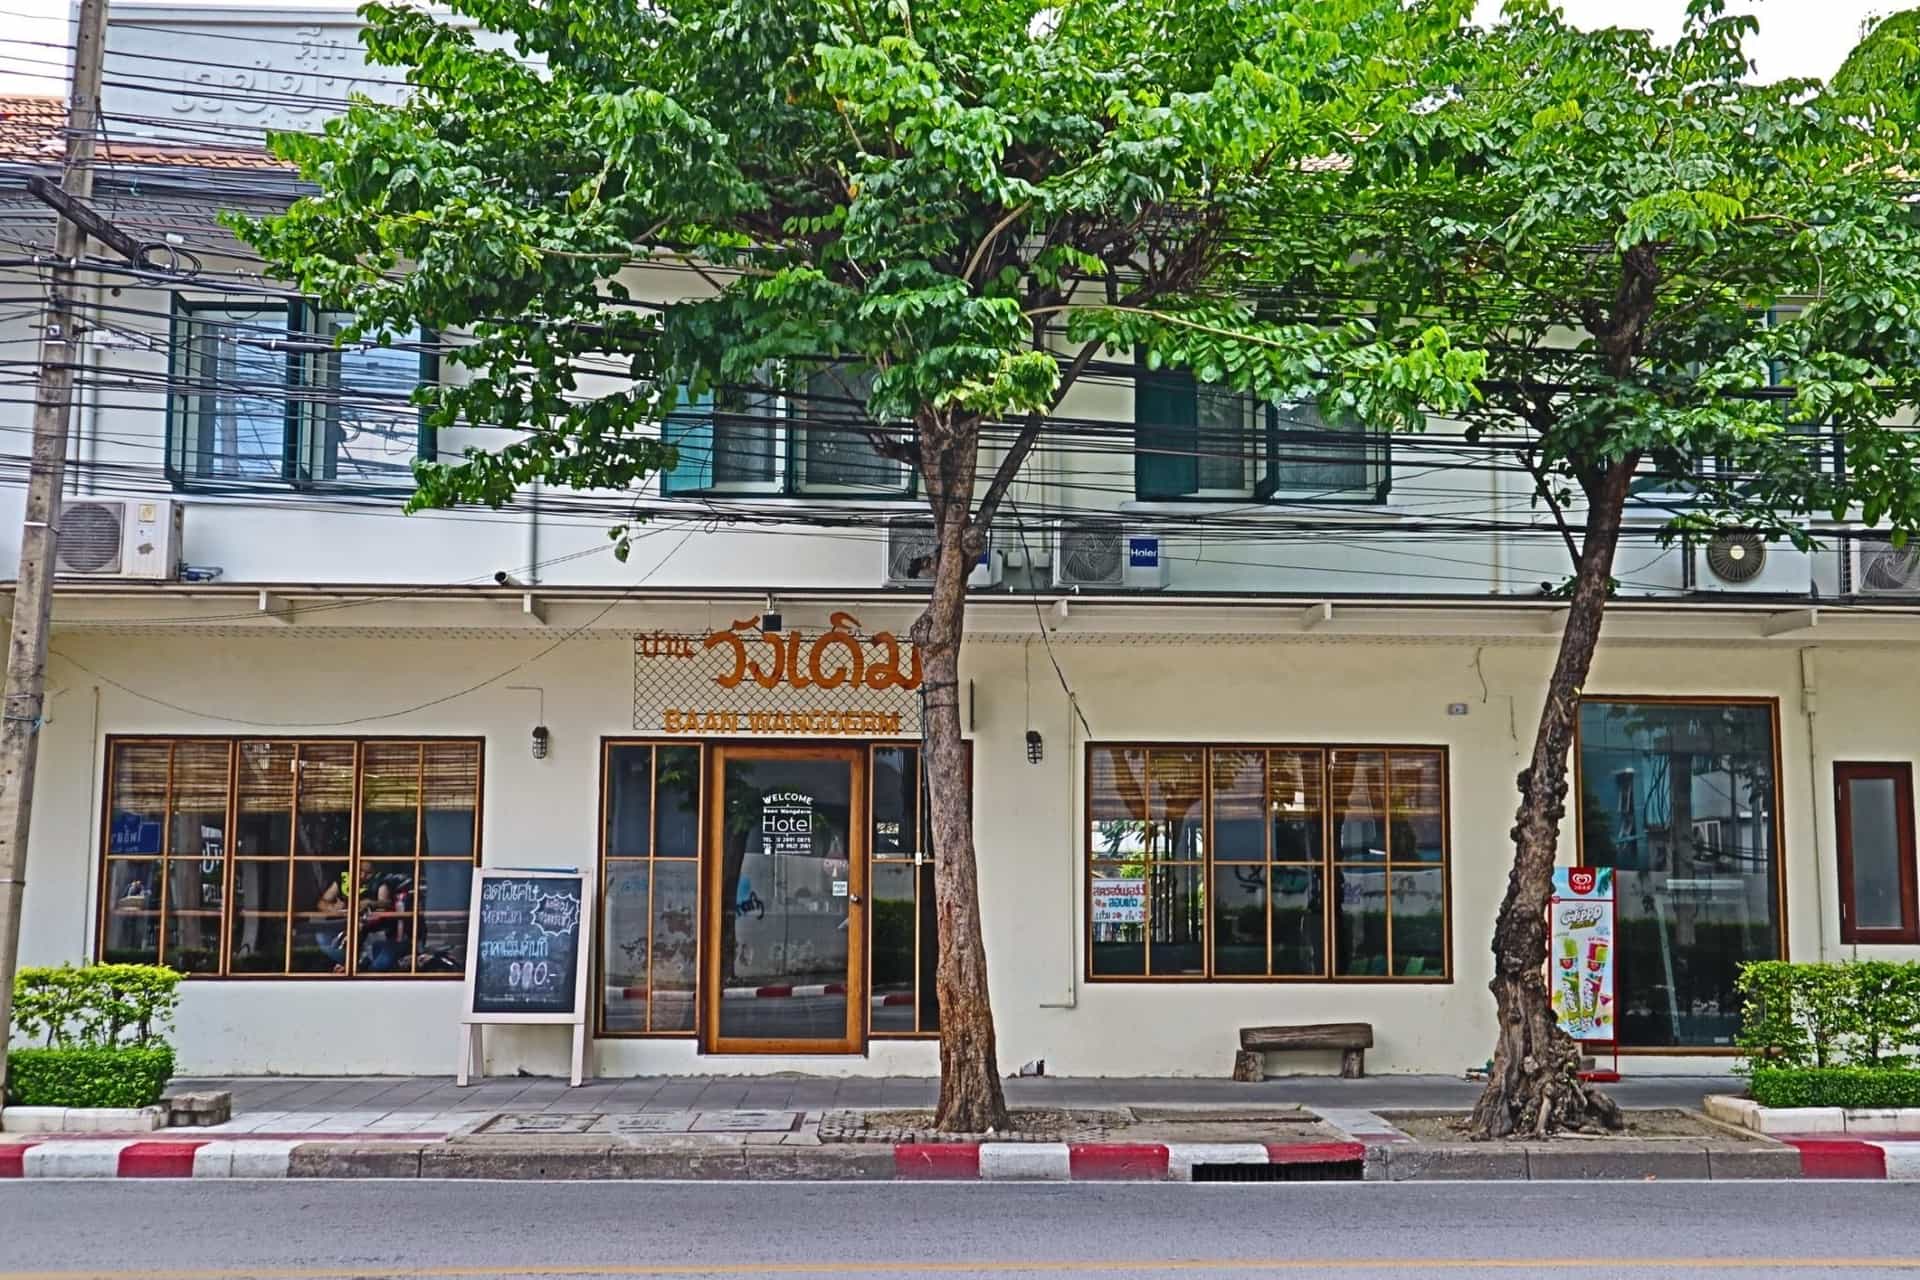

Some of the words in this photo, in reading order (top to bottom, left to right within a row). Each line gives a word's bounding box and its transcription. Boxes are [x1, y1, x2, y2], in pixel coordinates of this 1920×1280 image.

[1130, 547, 1157, 558] Haier
[639, 629, 695, 658] บ้าน
[703, 611, 924, 690] วังเดิม
[664, 706, 738, 734] BAAN
[750, 708, 901, 735] WANGDERM
[762, 792, 814, 804] WELCOME
[762, 815, 813, 832] Hotel
